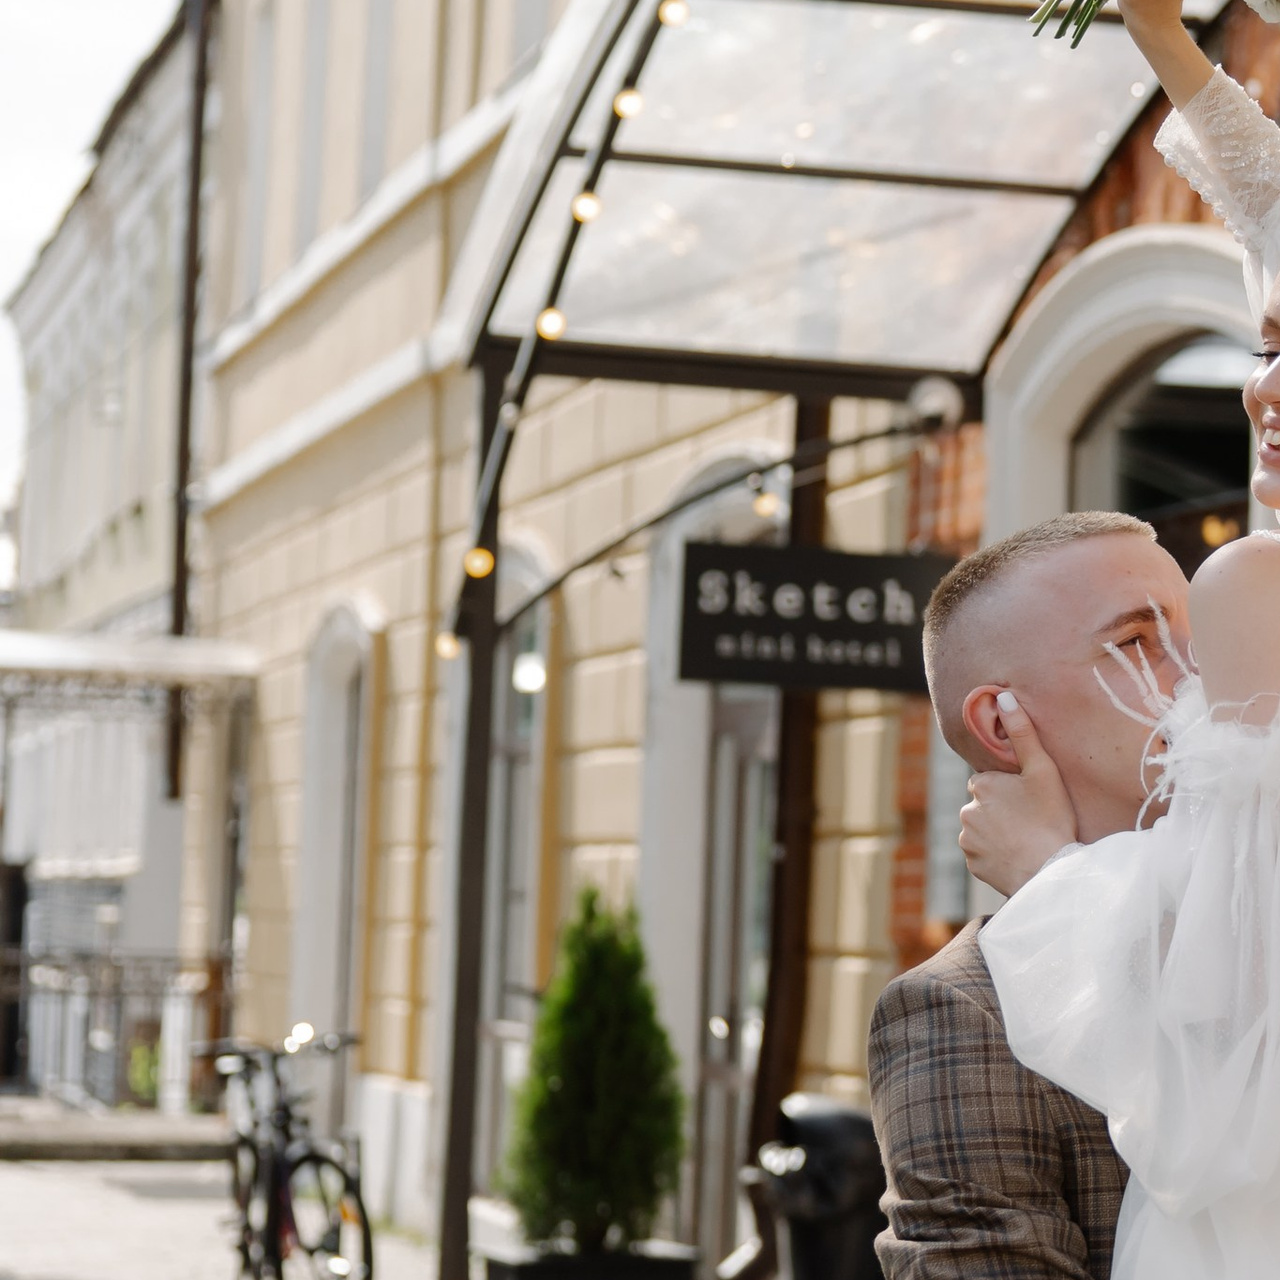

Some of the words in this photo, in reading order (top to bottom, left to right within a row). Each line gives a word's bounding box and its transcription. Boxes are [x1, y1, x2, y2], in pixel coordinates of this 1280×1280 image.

[698, 570, 916, 625] Sketch
[714, 631, 796, 663] mini
[806, 635, 902, 668] hotel
